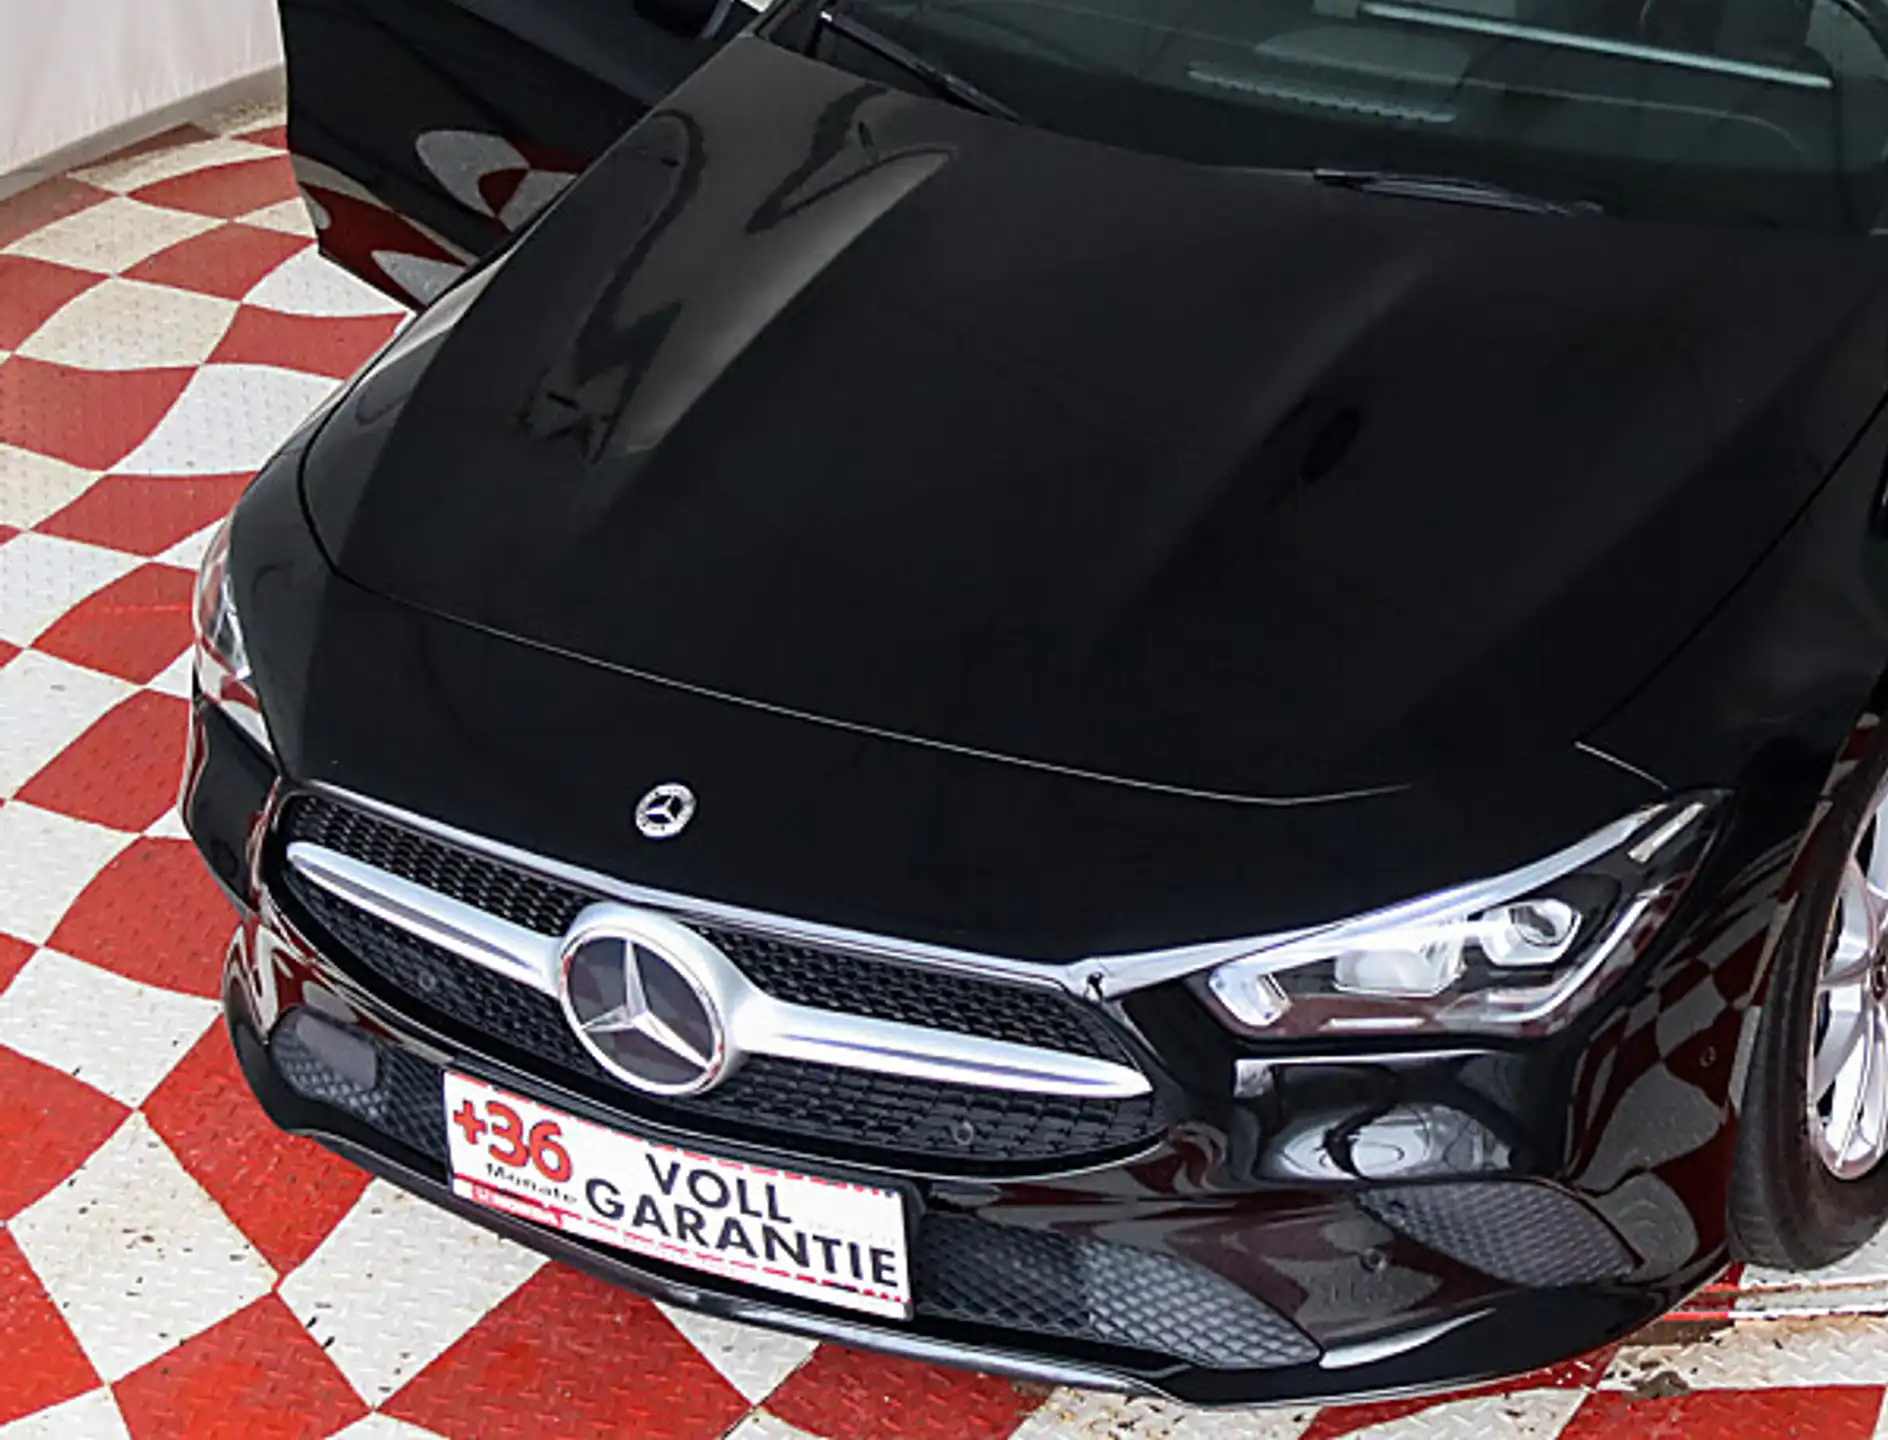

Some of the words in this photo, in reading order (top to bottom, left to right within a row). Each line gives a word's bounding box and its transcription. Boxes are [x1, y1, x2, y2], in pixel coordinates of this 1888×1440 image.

[452, 1097, 574, 1184] +36
[645, 1152, 793, 1224] VOLL
[585, 1179, 899, 1288] GARANTIE
